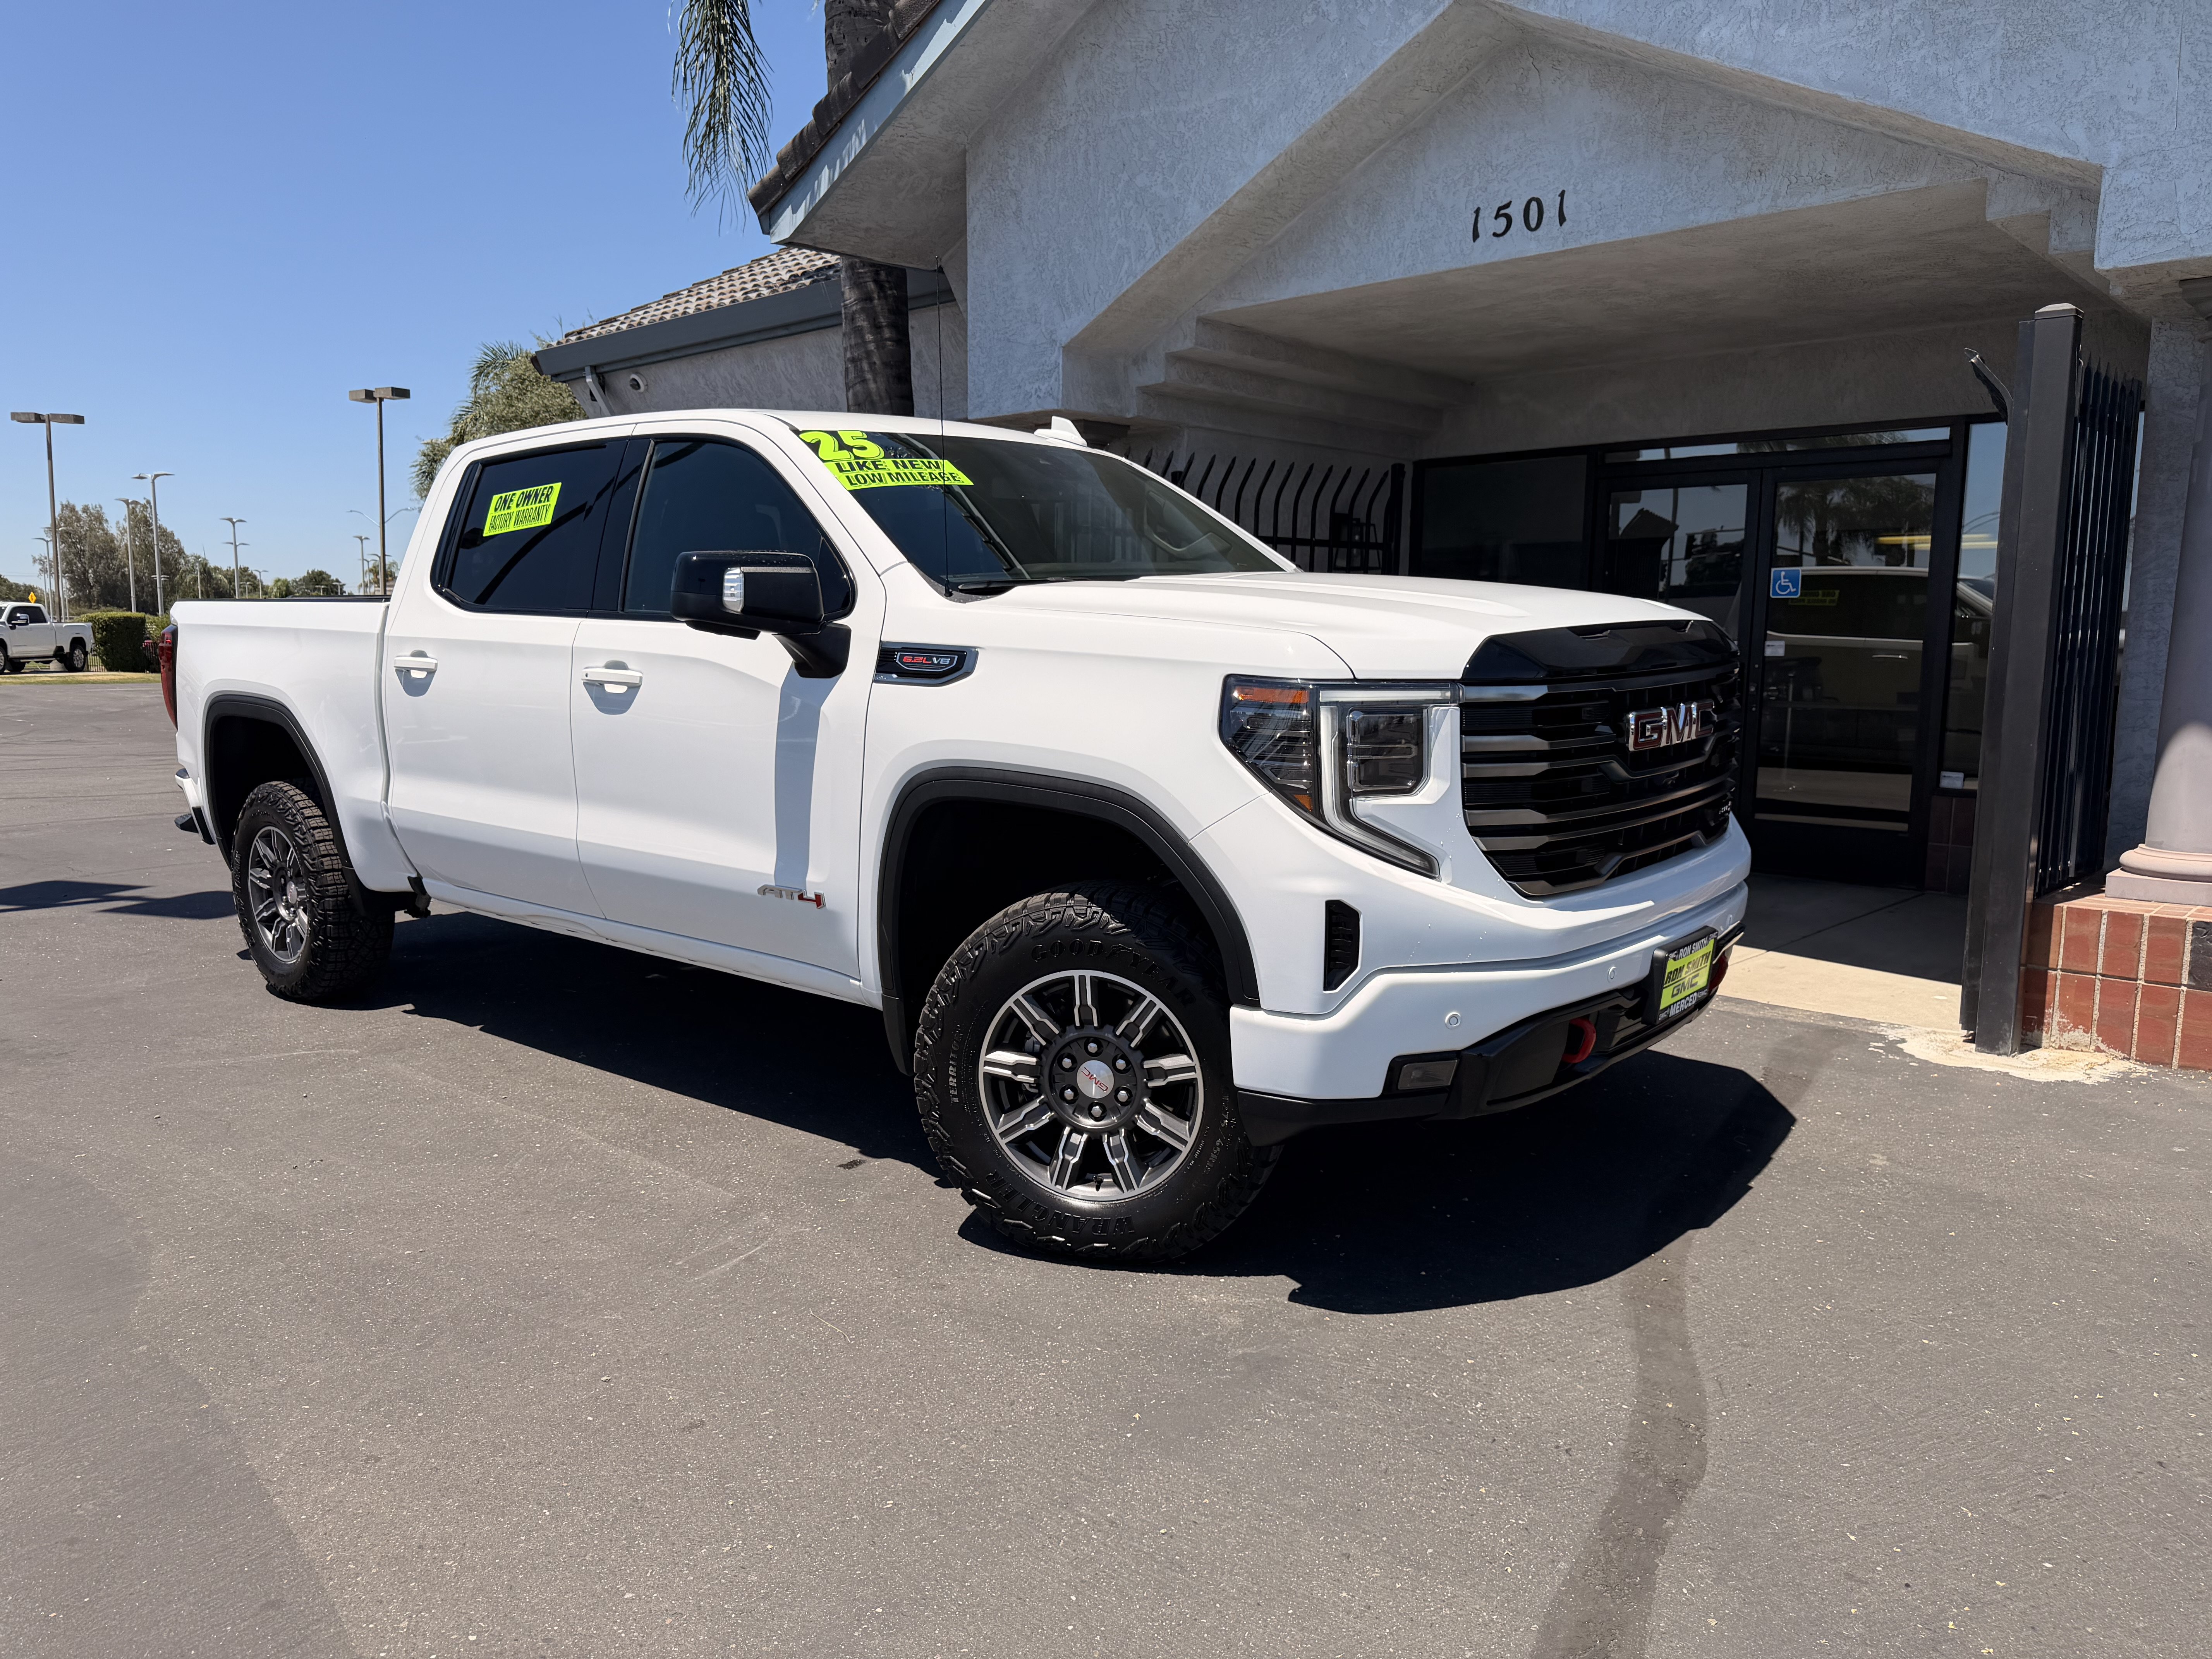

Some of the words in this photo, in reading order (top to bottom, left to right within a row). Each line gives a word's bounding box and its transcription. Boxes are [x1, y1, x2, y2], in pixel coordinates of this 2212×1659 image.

[1472, 189, 1566, 242] 1501
[799, 430, 885, 461] 25
[835, 460, 889, 473] LIKE
[892, 459, 944, 471] NEW
[845, 472, 887, 486] LOW
[890, 472, 963, 483] MILEAGE
[494, 493, 517, 513] ONE
[516, 486, 553, 508] OWNER
[488, 511, 514, 532] FACTORY
[514, 504, 550, 527] WARRANTY
[1629, 699, 1715, 752] GMC
[1679, 944, 1691, 959] RON
[1692, 936, 1709, 953] SMITH
[1031, 939, 1196, 1006] GOODYEAR
[1664, 963, 1685, 985] RON
[1686, 951, 1711, 974] SMITH
[1671, 973, 1700, 998] GMC
[1669, 993, 1697, 1017] MERCED
[1081, 1067, 1108, 1093] GMC
[985, 1169, 1135, 1235] WRANGLER
